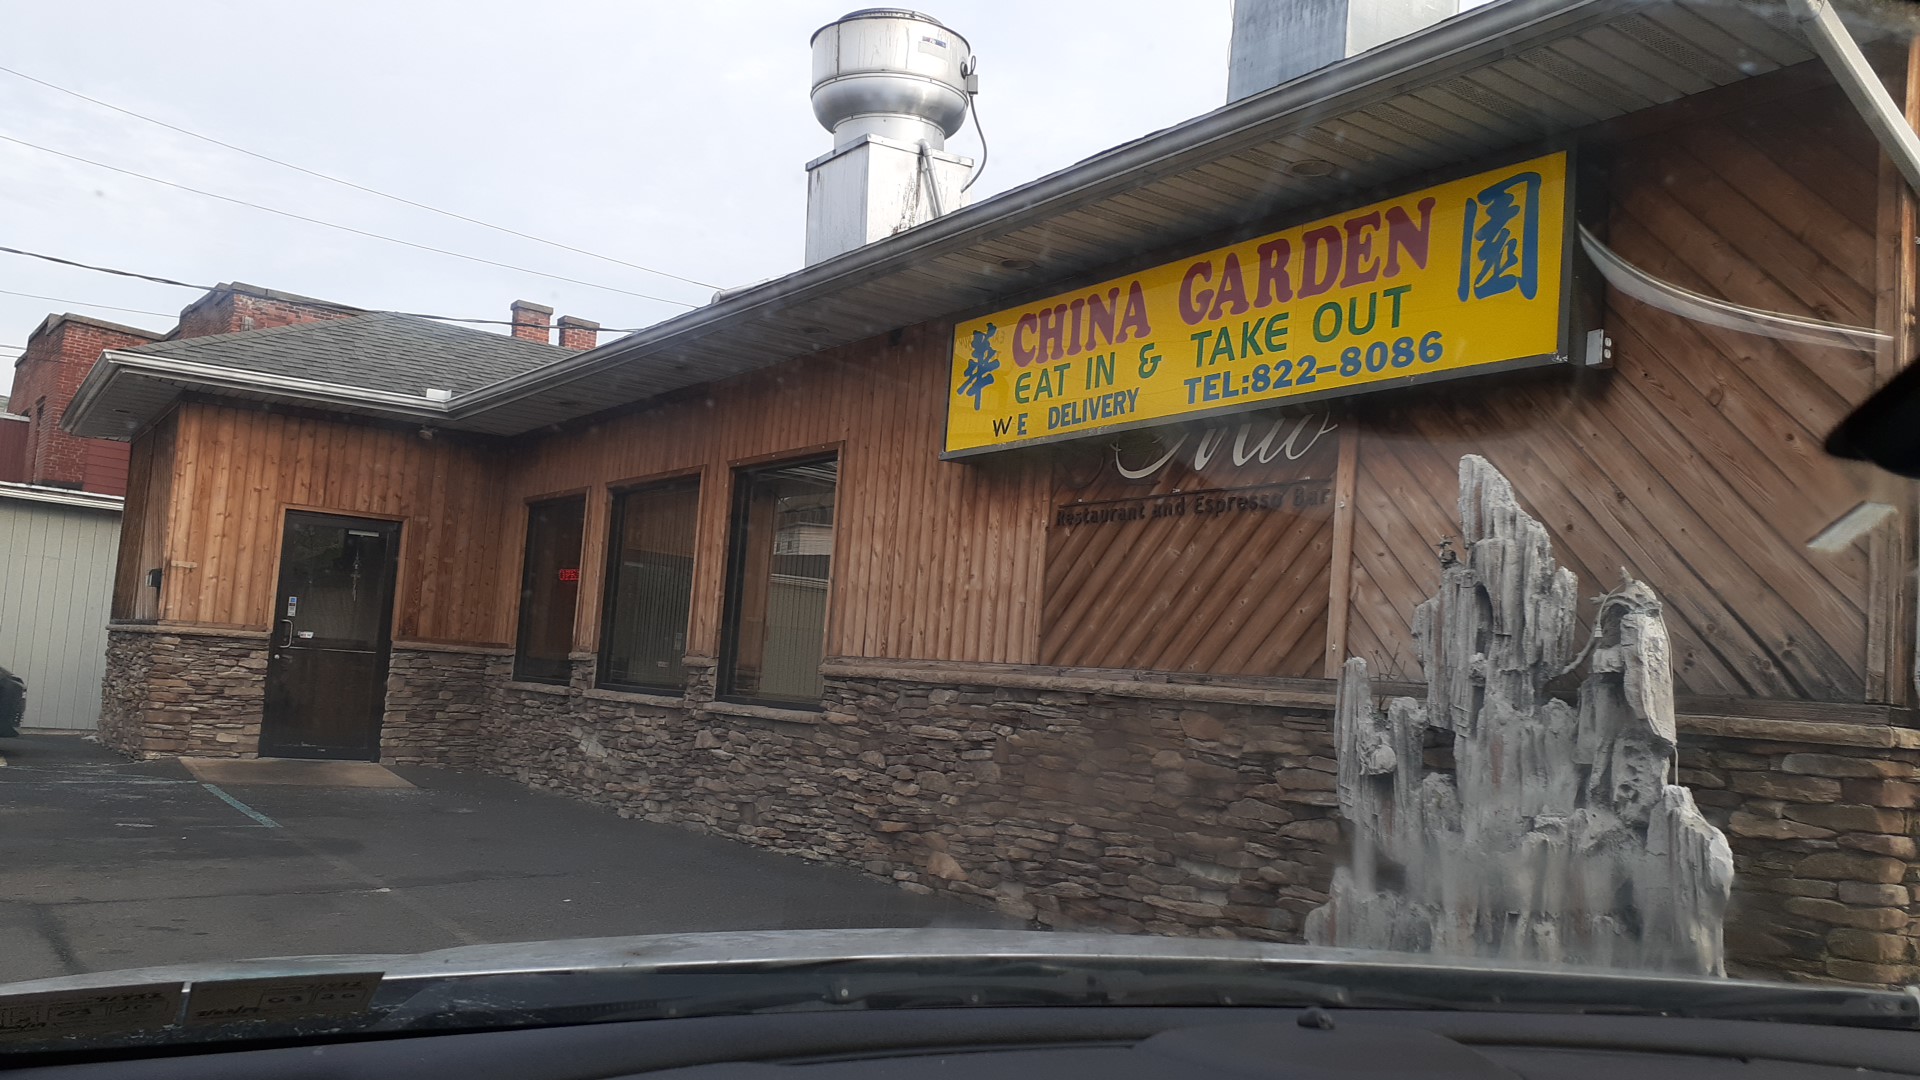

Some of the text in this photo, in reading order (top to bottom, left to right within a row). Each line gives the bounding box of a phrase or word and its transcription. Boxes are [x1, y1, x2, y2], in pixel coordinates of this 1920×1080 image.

[1012, 197, 1436, 367] CHINA GARDEN
[1015, 284, 1412, 404] EAT IN & TAKE OUT
[1184, 331, 1443, 405] TEL:822-8086
[993, 387, 1140, 437] WE DELIVERY
[1056, 486, 1331, 527] Restaurant and Espresso Bar
